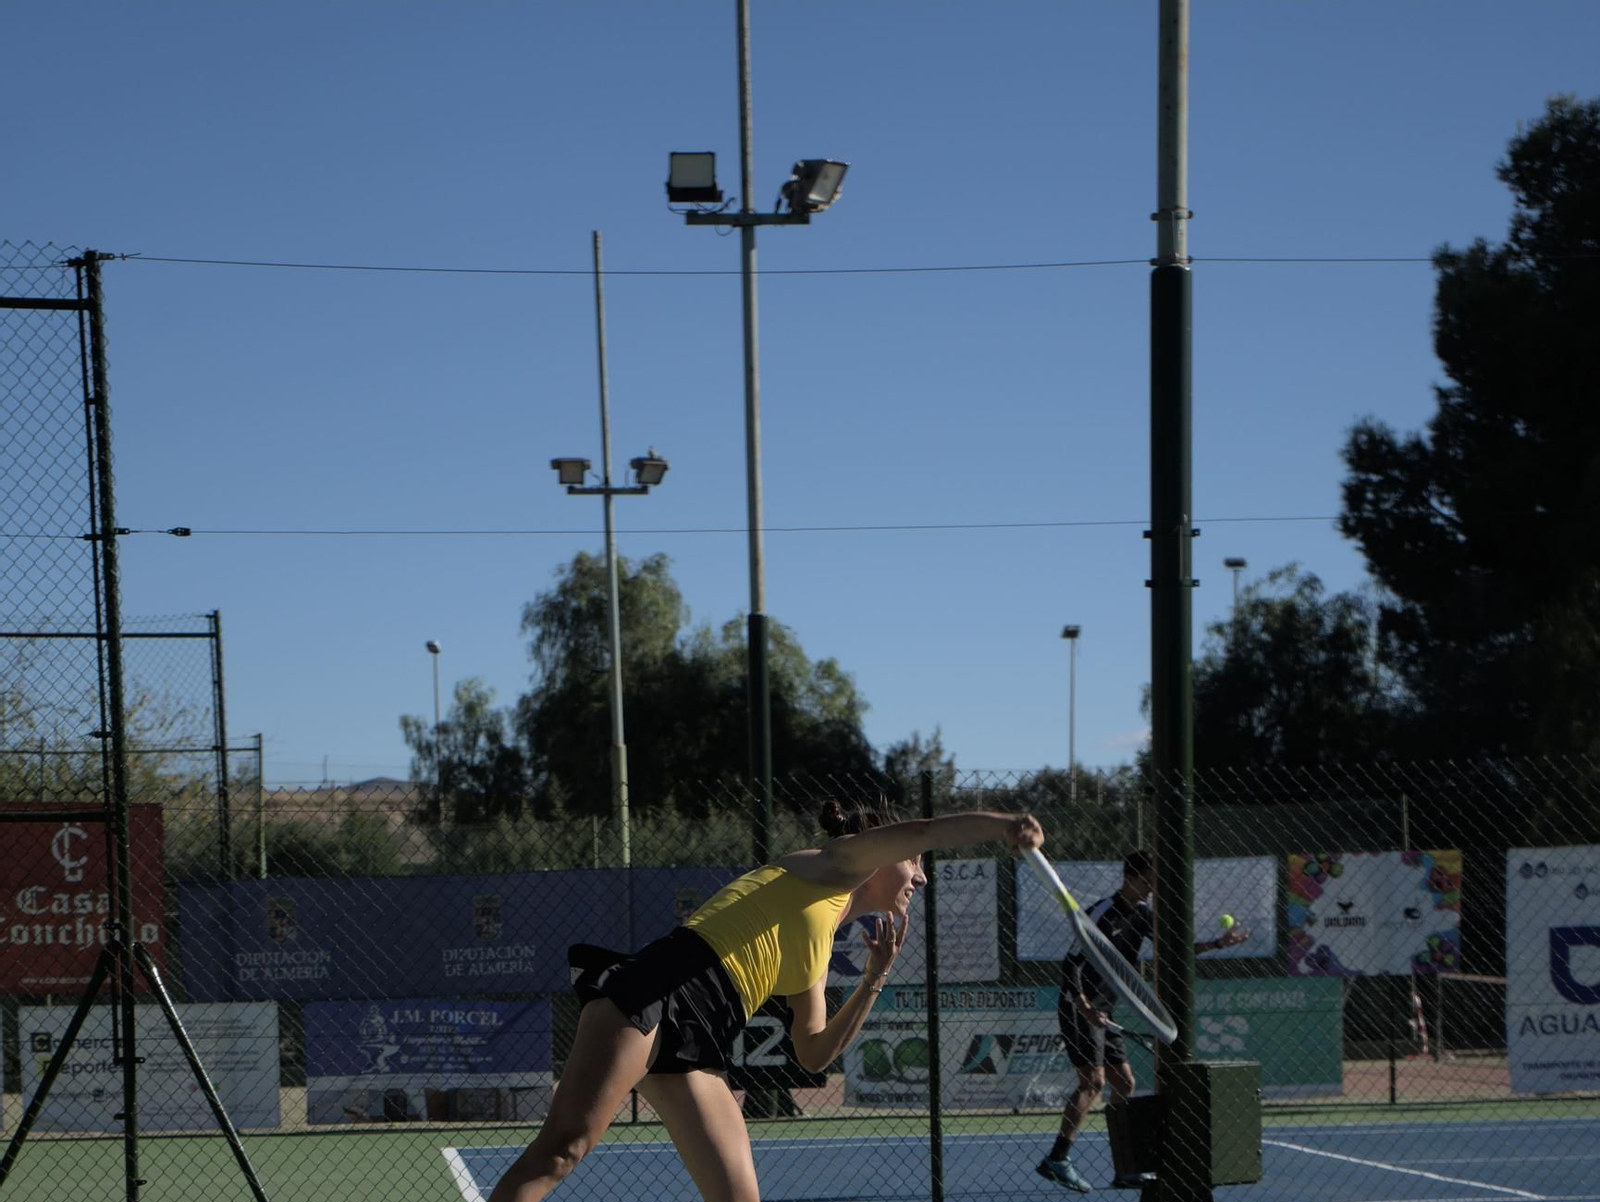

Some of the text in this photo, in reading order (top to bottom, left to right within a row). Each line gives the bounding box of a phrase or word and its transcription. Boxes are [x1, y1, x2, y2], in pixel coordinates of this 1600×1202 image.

[16, 885, 111, 915] Casa
[444, 963, 464, 977] DE
[978, 991, 1036, 1008] DEPORTES
[430, 1009, 504, 1025] PORCEL
[1014, 1034, 1066, 1053] SPOR
